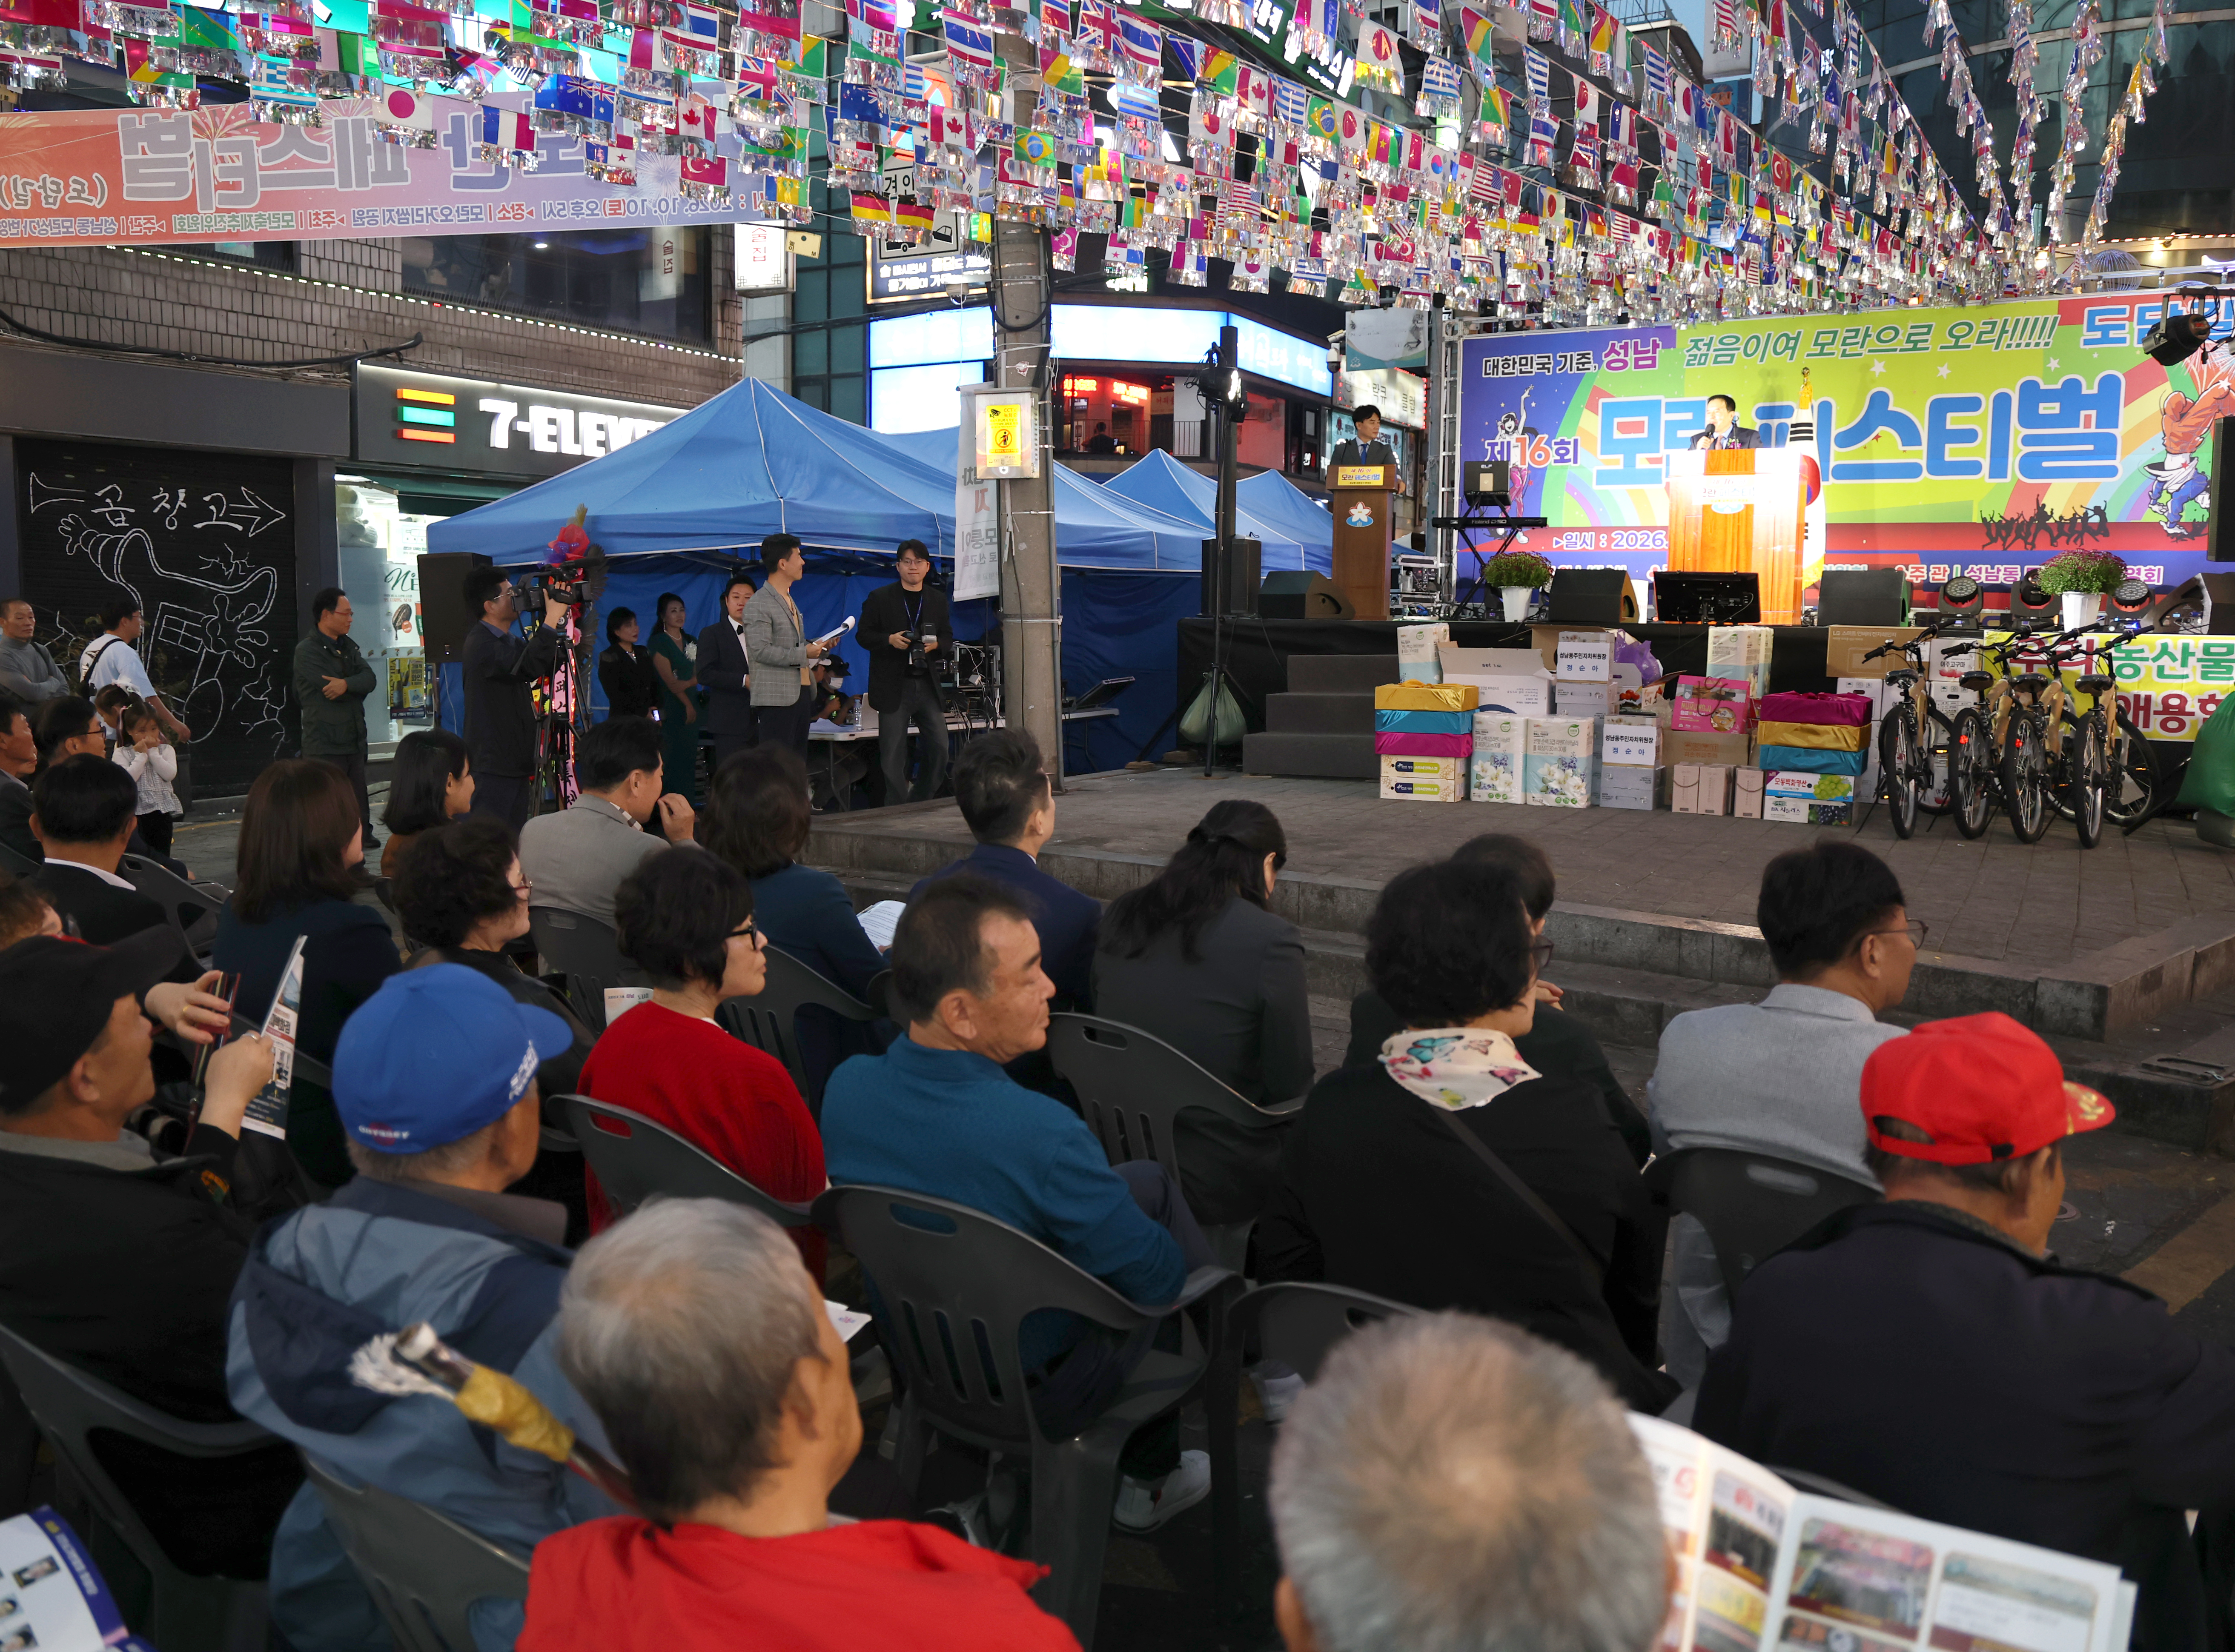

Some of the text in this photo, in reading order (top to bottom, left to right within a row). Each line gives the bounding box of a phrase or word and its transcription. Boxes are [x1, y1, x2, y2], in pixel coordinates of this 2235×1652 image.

[1483, 338, 1662, 378] 대한민국 기준, 성남
[1684, 329, 1804, 368] 젊음이여
[1805, 322, 1935, 360] 모란으로
[479, 398, 666, 457] 7-ELEV
[1484, 433, 1580, 469] 제16회
[1563, 532, 1596, 550] 일시
[1964, 564, 2021, 584] 성남동
[2111, 641, 2235, 681] 농산물
[1605, 734, 1654, 744] 성남동주민자치위원장
